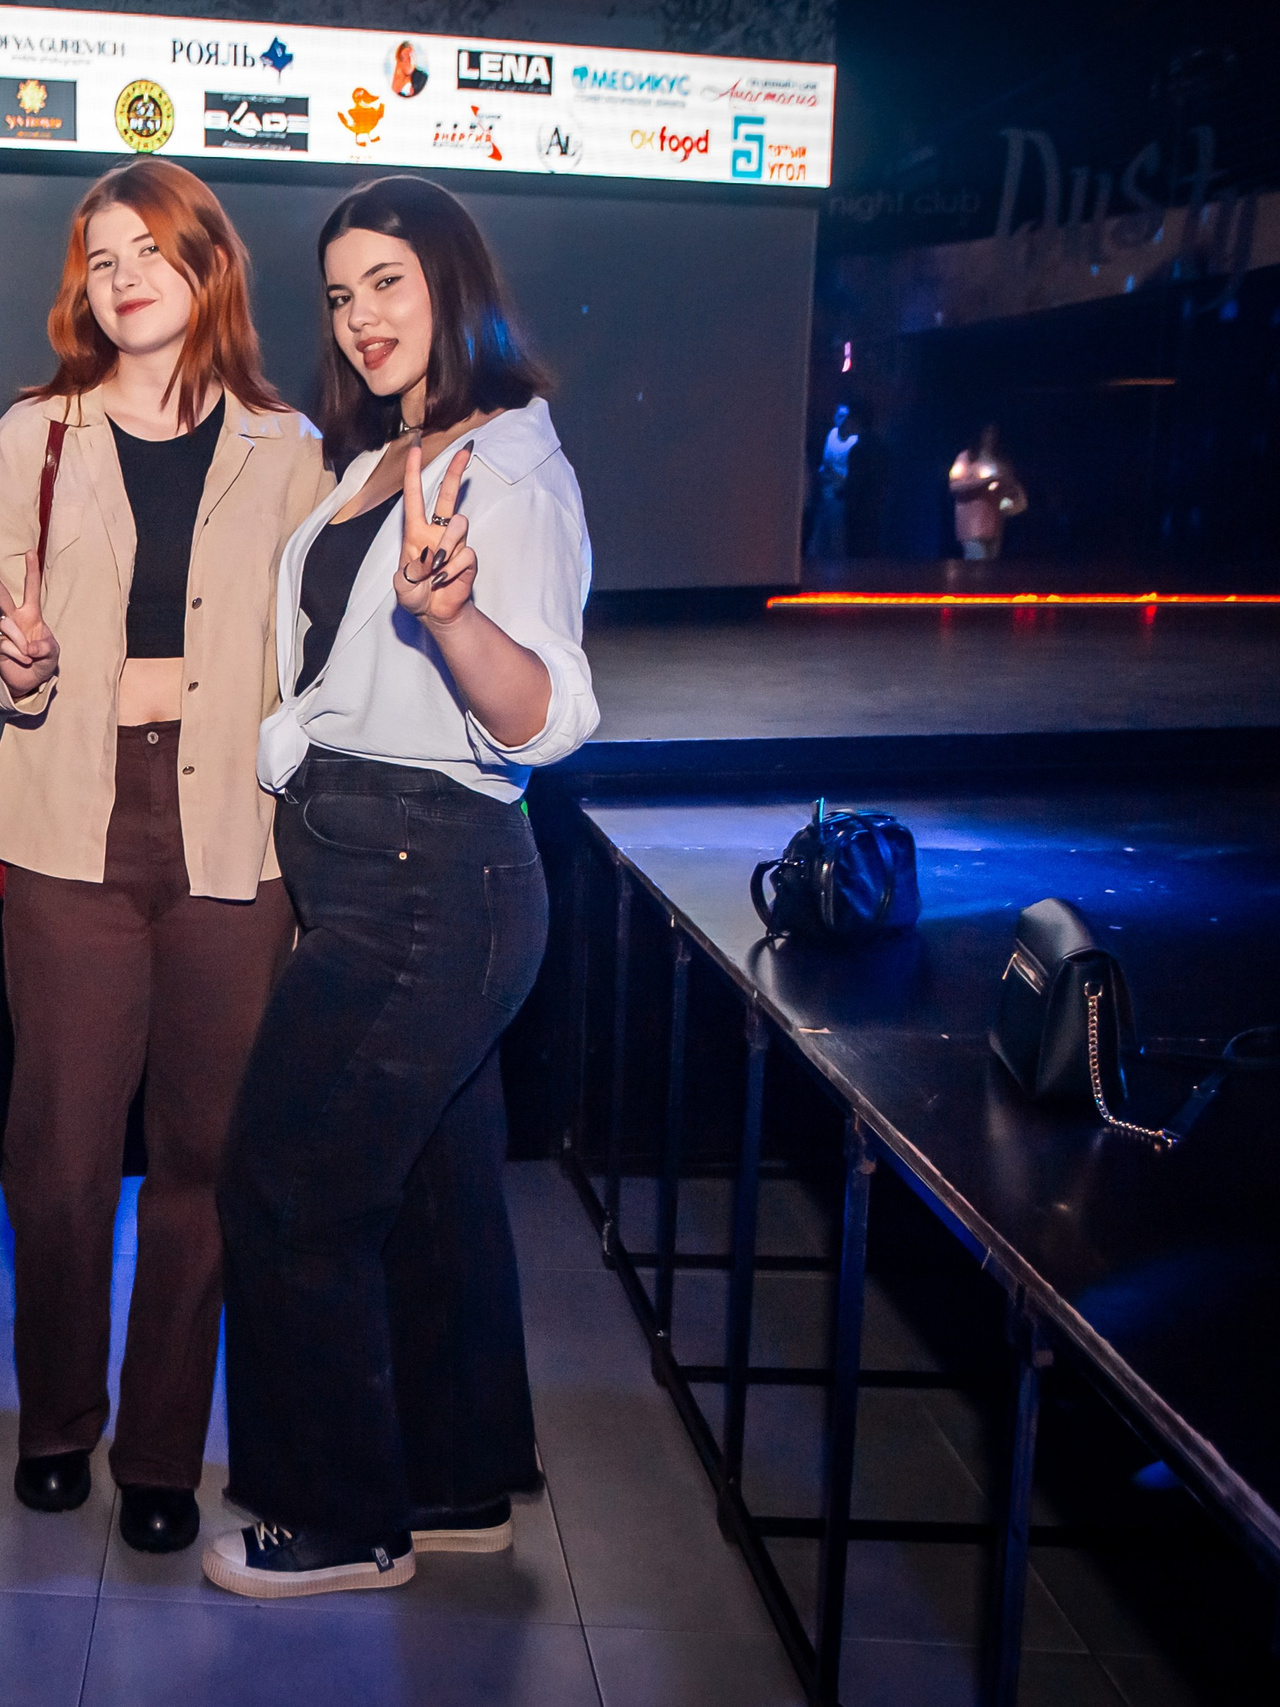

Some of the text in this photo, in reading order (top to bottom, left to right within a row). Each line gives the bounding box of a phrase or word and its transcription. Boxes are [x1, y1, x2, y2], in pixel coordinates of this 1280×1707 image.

[171, 39, 256, 68] РОЯЛЬ
[458, 50, 550, 85] LENA
[590, 68, 691, 96] МЕДИКУС
